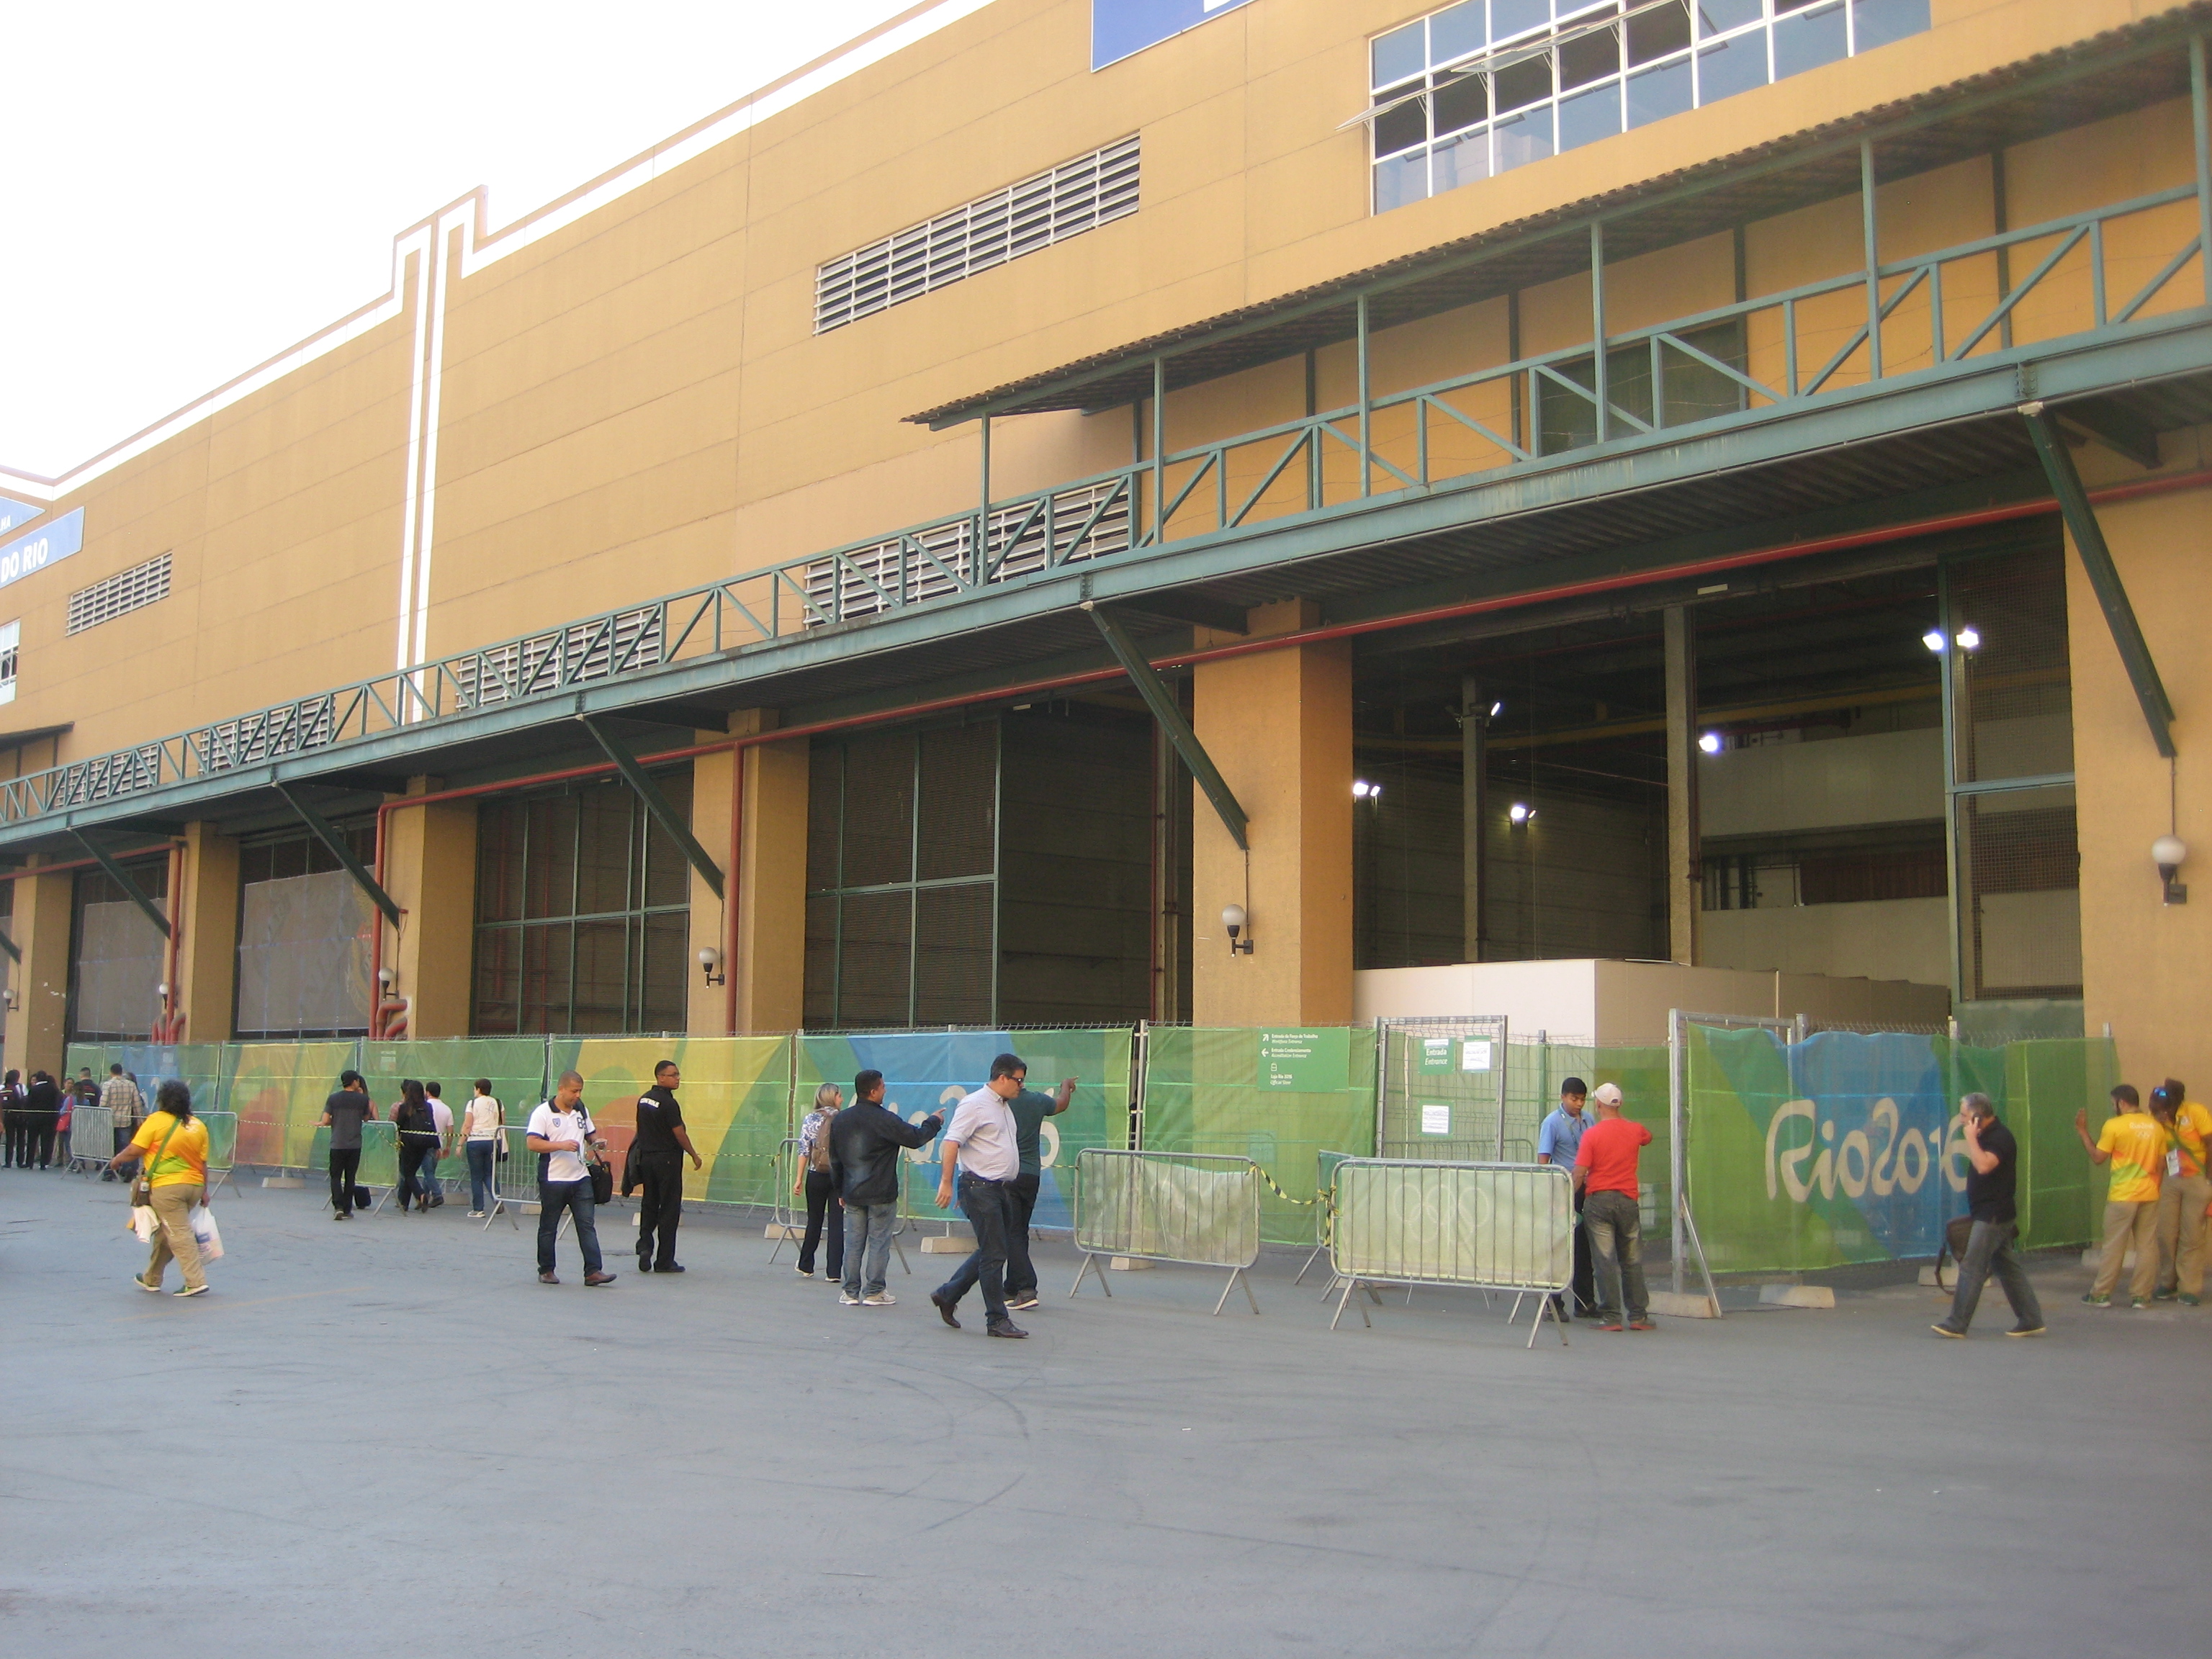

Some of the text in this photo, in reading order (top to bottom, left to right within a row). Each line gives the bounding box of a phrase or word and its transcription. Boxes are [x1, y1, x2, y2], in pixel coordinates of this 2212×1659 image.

[0, 515, 11, 531] HA
[1, 538, 48, 583] DO RIO
[1426, 1048, 1447, 1056] Entrada
